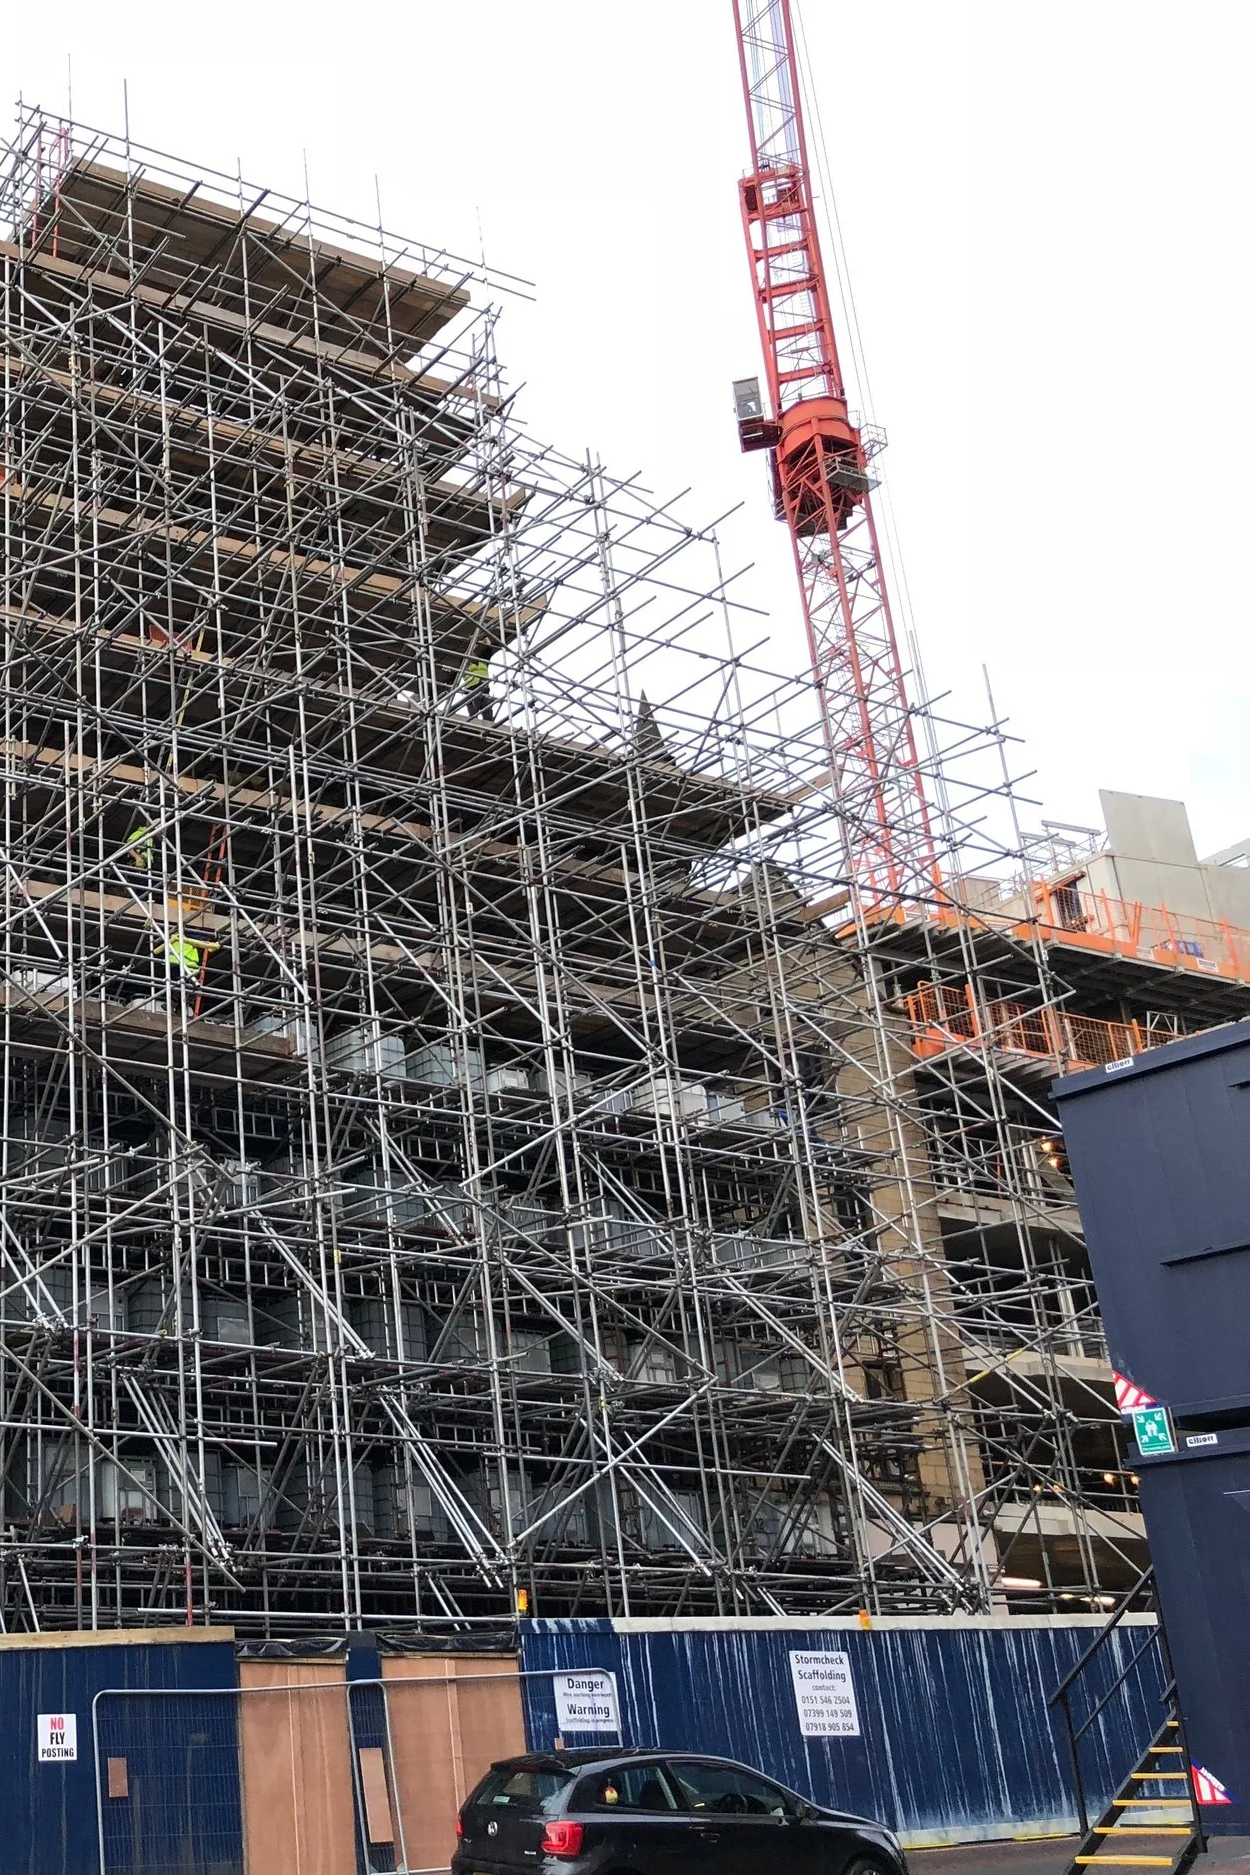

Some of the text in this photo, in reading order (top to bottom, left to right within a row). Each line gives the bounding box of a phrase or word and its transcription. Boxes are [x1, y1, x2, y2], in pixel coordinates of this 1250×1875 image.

[794, 1654, 845, 1665] Stormcheck
[797, 1669, 847, 1683] Scaffolding
[567, 1677, 604, 1692] Danger
[801, 1695, 818, 1704] 0151
[820, 1695, 833, 1705] 546
[567, 1703, 610, 1718] Warning
[803, 1709, 825, 1718] 07399
[826, 1709, 839, 1718] 149
[50, 1717, 64, 1730] NO
[805, 1722, 827, 1731] 07918
[827, 1722, 841, 1731] 905
[50, 1732, 65, 1745] FLY
[41, 1748, 75, 1758] POSTING
